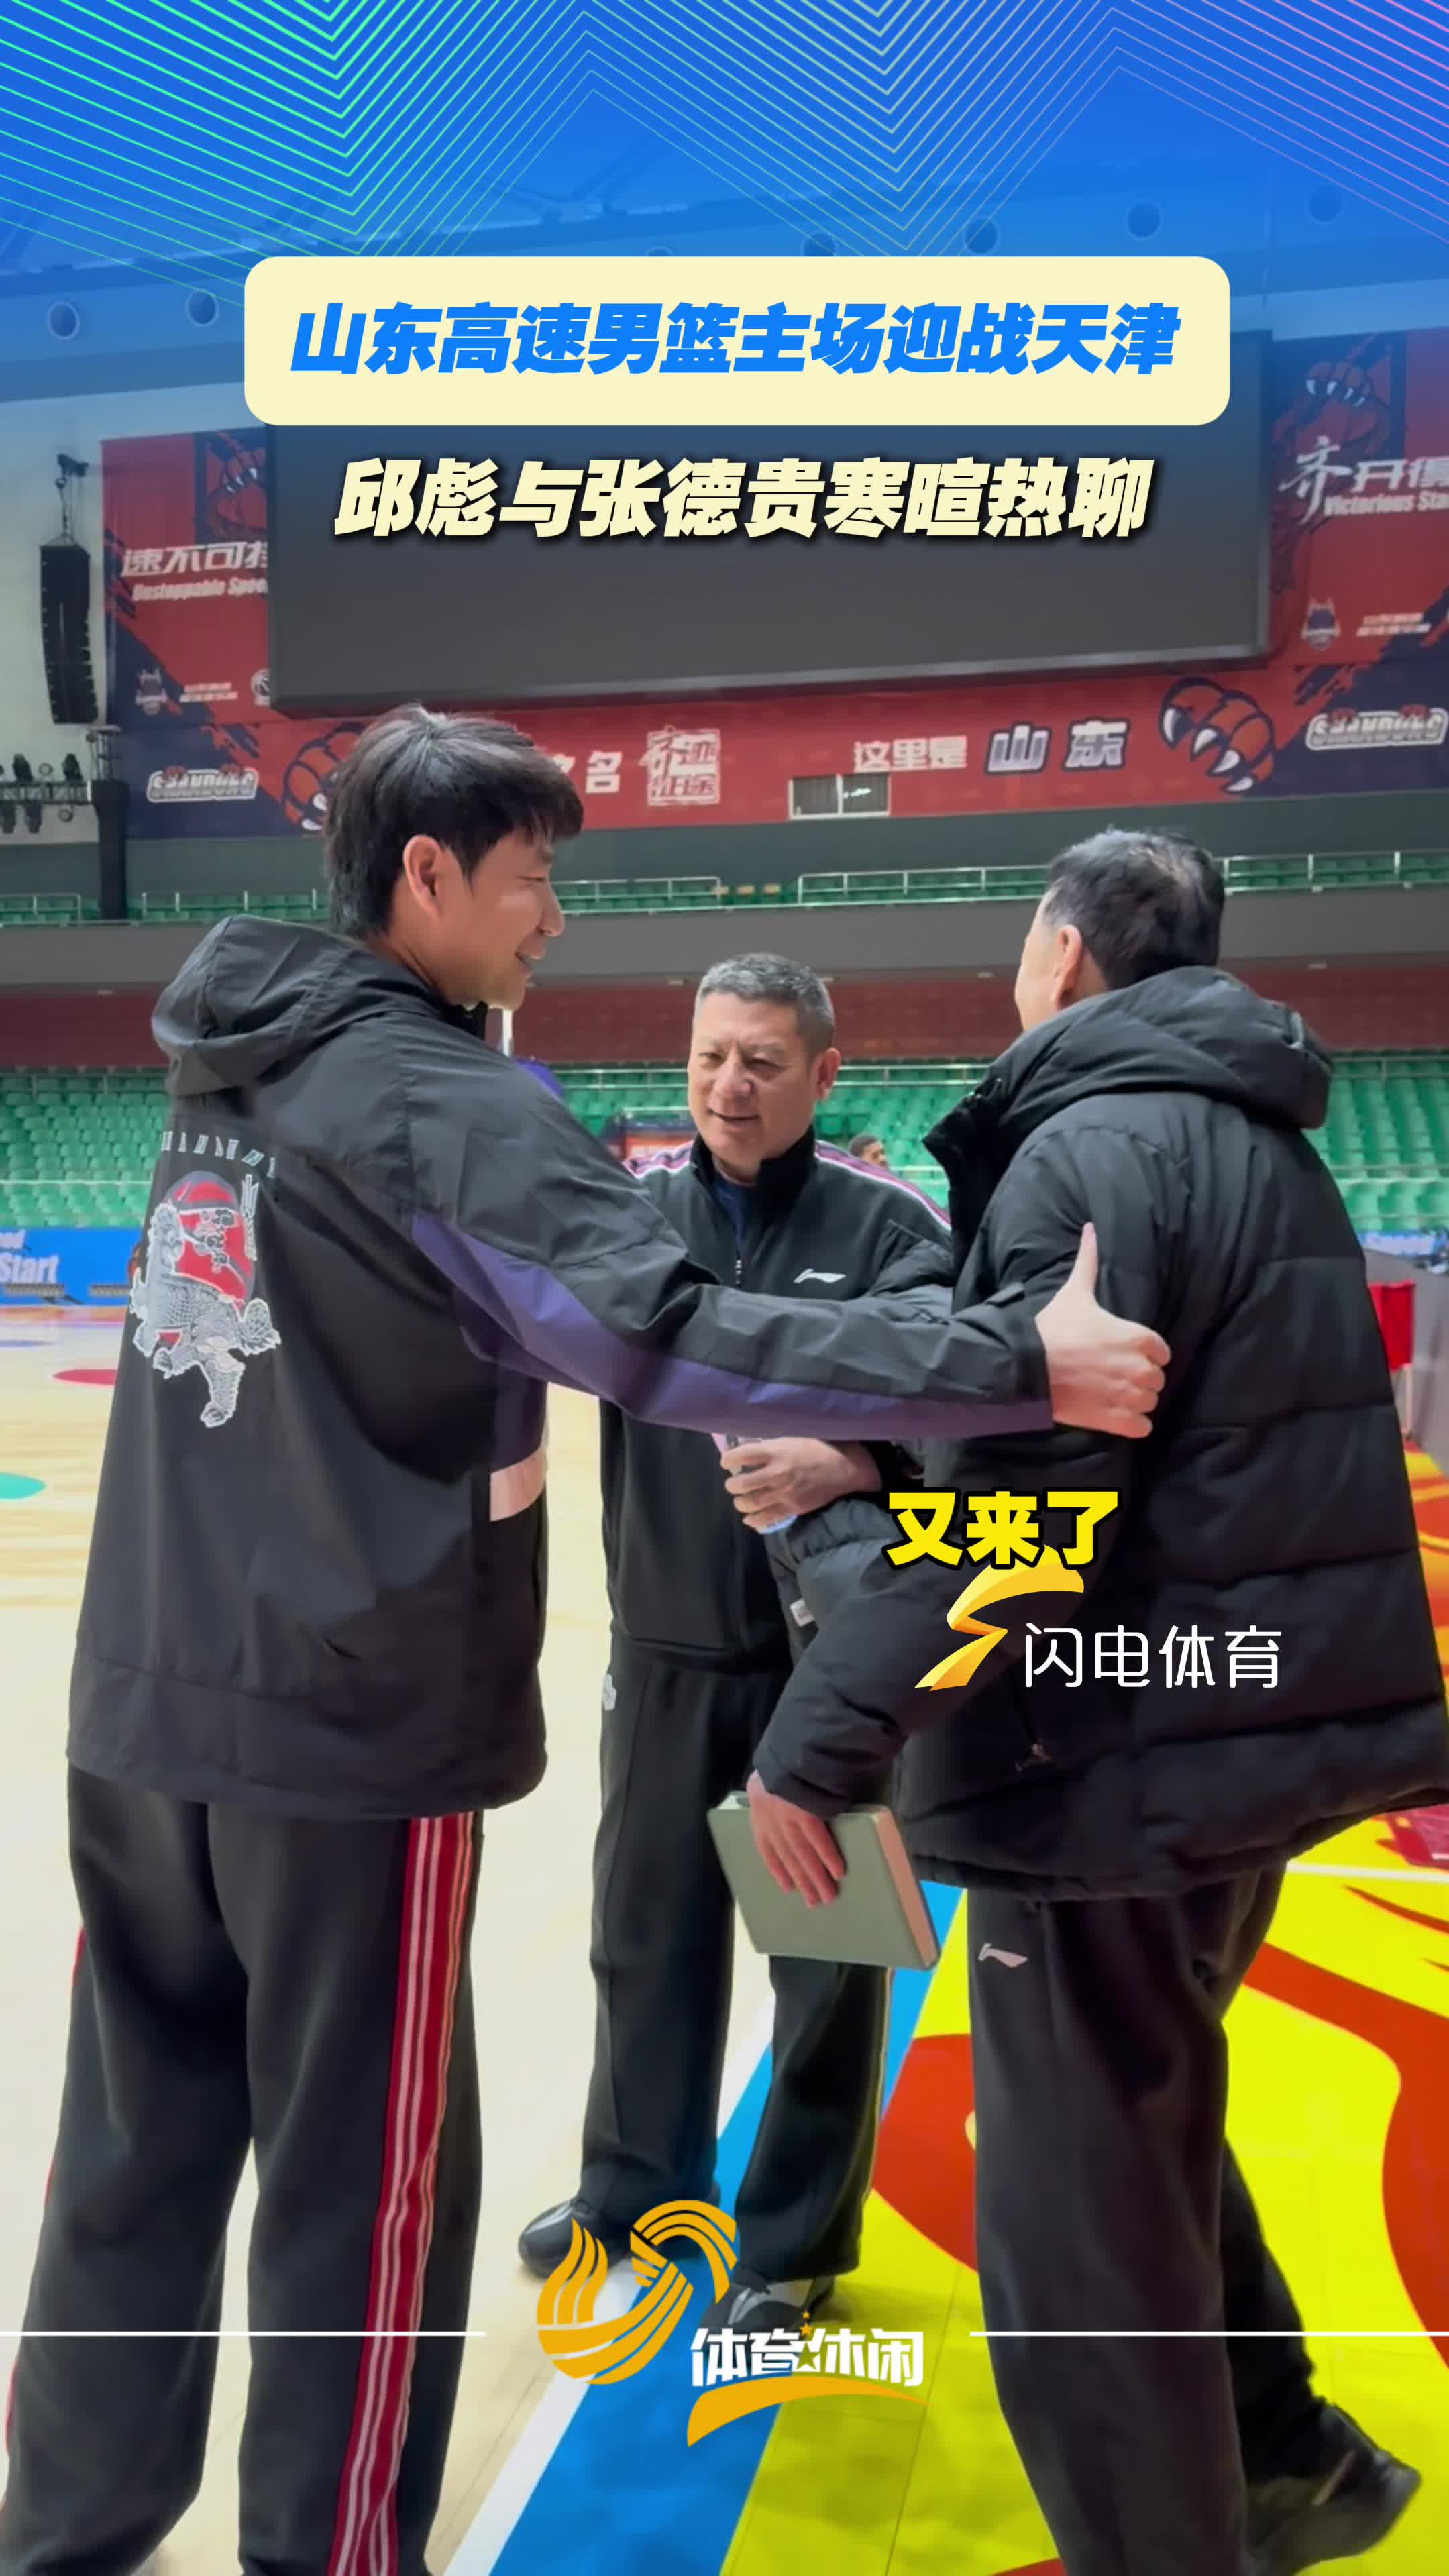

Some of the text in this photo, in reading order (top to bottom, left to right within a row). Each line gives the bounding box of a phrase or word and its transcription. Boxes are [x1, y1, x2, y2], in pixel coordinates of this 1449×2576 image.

[1324, 494, 1415, 517] Victorious
[131, 578, 226, 602] Unstoppable
[853, 720, 1129, 773] 这里是 山东
